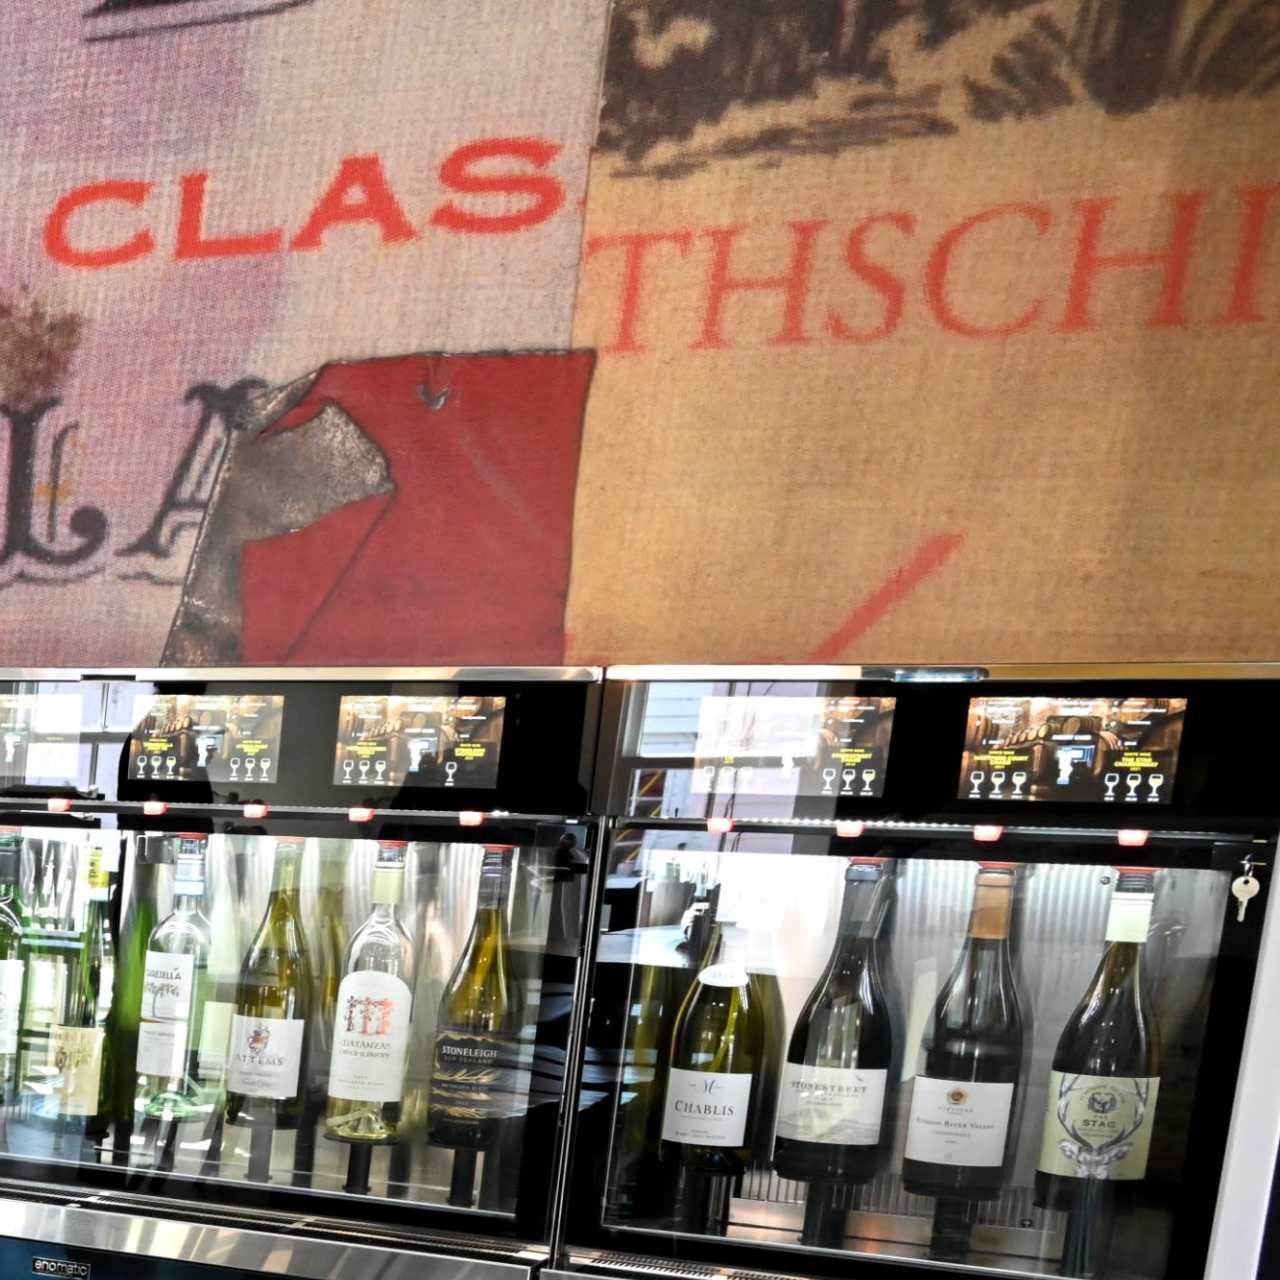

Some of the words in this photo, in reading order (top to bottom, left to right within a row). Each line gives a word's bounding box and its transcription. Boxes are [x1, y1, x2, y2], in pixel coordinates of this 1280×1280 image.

[43, 137, 566, 270] CLAS
[441, 1045, 497, 1058] STONELEIGH
[673, 1099, 735, 1116] CHABLIS
[1081, 1119, 1116, 1129] STAG
[34, 1259, 88, 1277] enomatic
